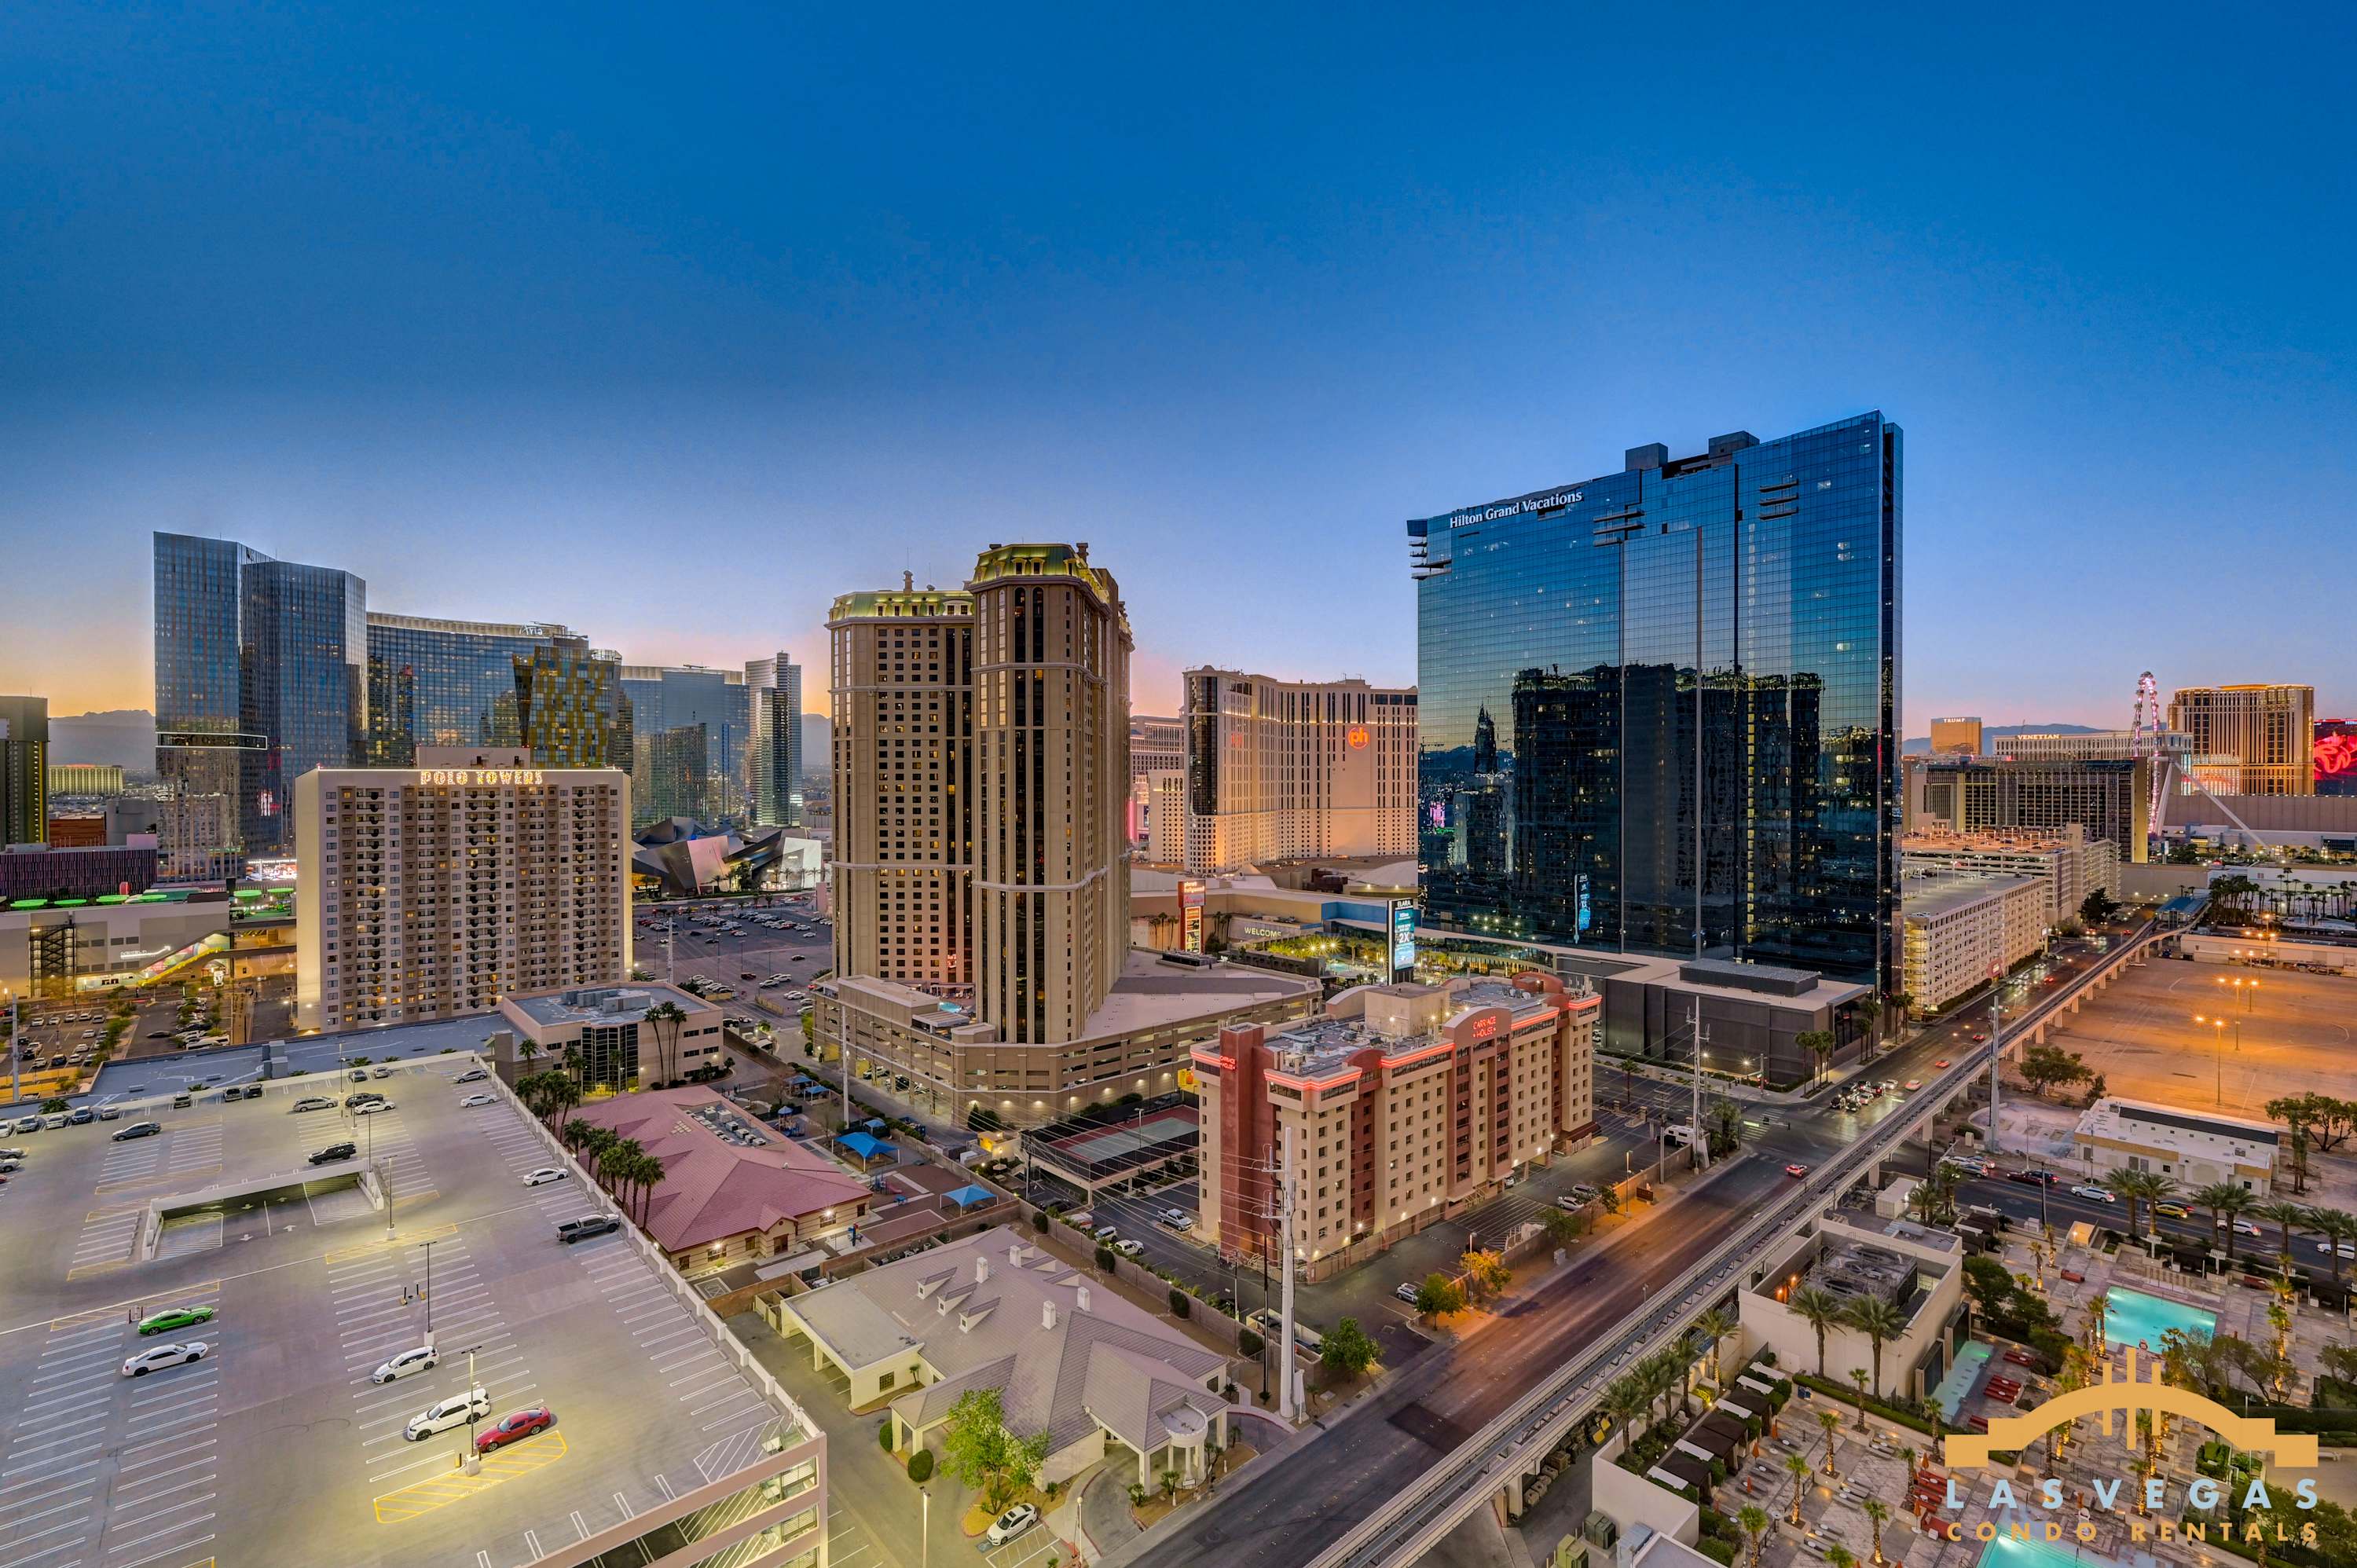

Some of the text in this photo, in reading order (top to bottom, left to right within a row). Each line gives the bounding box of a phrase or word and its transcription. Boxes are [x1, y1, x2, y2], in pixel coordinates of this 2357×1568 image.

[1450, 491, 1584, 529] Hilton Grand Vacations
[420, 770, 543, 786] POLO TOWERS
[1244, 926, 1282, 937] WELCOME
[1472, 1016, 1497, 1030] CARRAGE
[1476, 1026, 1494, 1038] HOUSE
